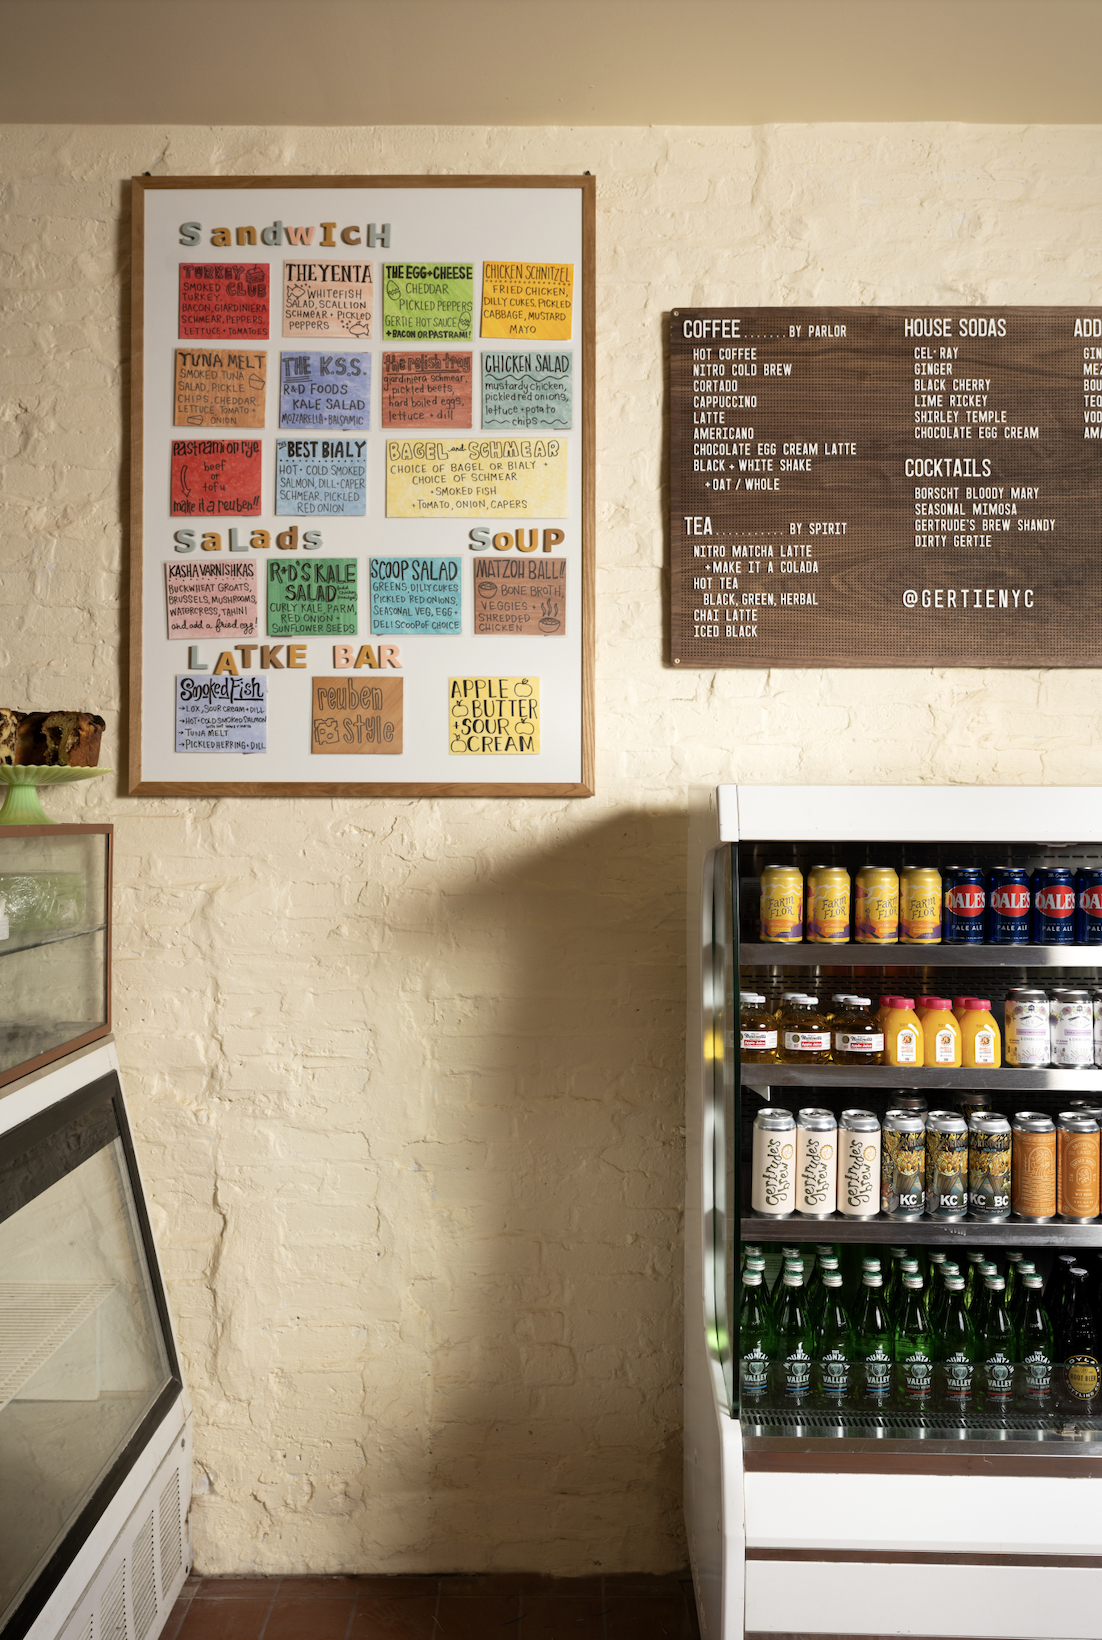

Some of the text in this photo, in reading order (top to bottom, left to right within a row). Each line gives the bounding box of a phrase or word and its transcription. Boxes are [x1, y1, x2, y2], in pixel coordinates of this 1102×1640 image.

[183, 266, 245, 280] TURKEY
[486, 264, 570, 282] CHICKEN SCHNITZEL
[184, 283, 266, 297] SMOKED CLUB
[406, 283, 449, 295] CHEDDAR
[493, 285, 568, 297] FRIED CHICKEN,
[319, 300, 366, 309] SCALLION
[399, 299, 473, 312] PICKLED PEPPERS
[416, 317, 457, 327] HOT SAUCE
[528, 312, 566, 321] MUSTARD
[510, 325, 536, 334] MAYO
[789, 323, 803, 339] BY
[807, 323, 848, 339] PARLOR
[904, 317, 1007, 338] HOUSE SODAS
[178, 352, 265, 369] TUNA MELT
[693, 347, 757, 361] HOT COFFEE
[283, 356, 311, 377] THE
[485, 355, 569, 373] CHICKEN SALAD
[693, 363, 793, 377] NITRO COLD BREW
[914, 362, 953, 376] GINGER
[180, 369, 244, 380] SMOKED TUNA
[693, 379, 738, 393] CORTADO
[914, 378, 991, 392] BLACK CHERRY
[293, 399, 365, 410] KALE SALAD
[389, 394, 437, 407] hard boiled
[693, 395, 758, 409] CAPPUCCINO
[914, 394, 989, 408] LIME RICKEY
[389, 410, 453, 422] lettuce dill
[693, 411, 726, 425] LATTE
[914, 410, 1008, 424] SHIRLEY TEMPLE
[693, 426, 754, 440] AMERICANO
[914, 426, 1040, 440] CHOCOLATE EGG CREAM
[288, 441, 366, 458] BEST BIALY
[389, 440, 559, 461] BAGEL SCHMEAR
[693, 442, 857, 456] CHOCOLATE EGG CREAM LATTE
[204, 460, 226, 471] beef
[279, 465, 364, 476] HOT COLD SMOKED
[390, 464, 427, 474] CHOICE
[451, 463, 484, 472] BAGEL
[490, 462, 503, 470] OR
[508, 461, 536, 470] BIALY
[693, 458, 812, 472] BLACK WHITE SHAKE
[904, 458, 993, 479] COCKTAILS
[412, 473, 517, 485] CHOICE OF SCHMEAR
[744, 477, 780, 491] WHOLE
[914, 486, 1041, 500] BORSCHT BLOODY MARY
[297, 502, 344, 512] RED ONION
[914, 502, 1018, 516] SEASONAL MIMOSA
[789, 521, 803, 536] BY
[808, 521, 848, 536] SPIRIT
[982, 518, 1011, 532] BREW
[1017, 518, 1056, 532] SHANDY
[914, 534, 993, 548] DIRTY GERTIE
[693, 544, 813, 558] NITRO MATCHA LATTE
[371, 559, 457, 581] SCOOP SALAD
[476, 560, 525, 578] MATZOH
[748, 560, 820, 574] IT COLADA
[693, 576, 739, 590] HOT TEA
[285, 584, 336, 602] SALAD
[703, 592, 820, 608] BLACK, GREEN, HERBAL
[902, 589, 1035, 609] @GERTIENYC
[481, 601, 527, 611] VEGGIES
[281, 615, 333, 623] RED ONION
[478, 613, 530, 622] SHREDDED
[693, 608, 758, 622] CHAI LATTE
[326, 624, 355, 633] SEEDS
[479, 624, 522, 632] CHICKEN
[693, 624, 758, 638] ICED BLACK
[188, 644, 403, 675] LATKE BAR
[317, 678, 383, 710] reuben
[451, 679, 508, 698] APPLE
[472, 699, 538, 719] BUTTER
[343, 714, 394, 744] style
[467, 736, 534, 752] CREAM
[787, 1374, 809, 1383] VALLEY
[823, 1375, 848, 1384] VALLEY
[947, 1379, 972, 1387] VALLEY
[987, 1379, 1012, 1388] VALLEY
